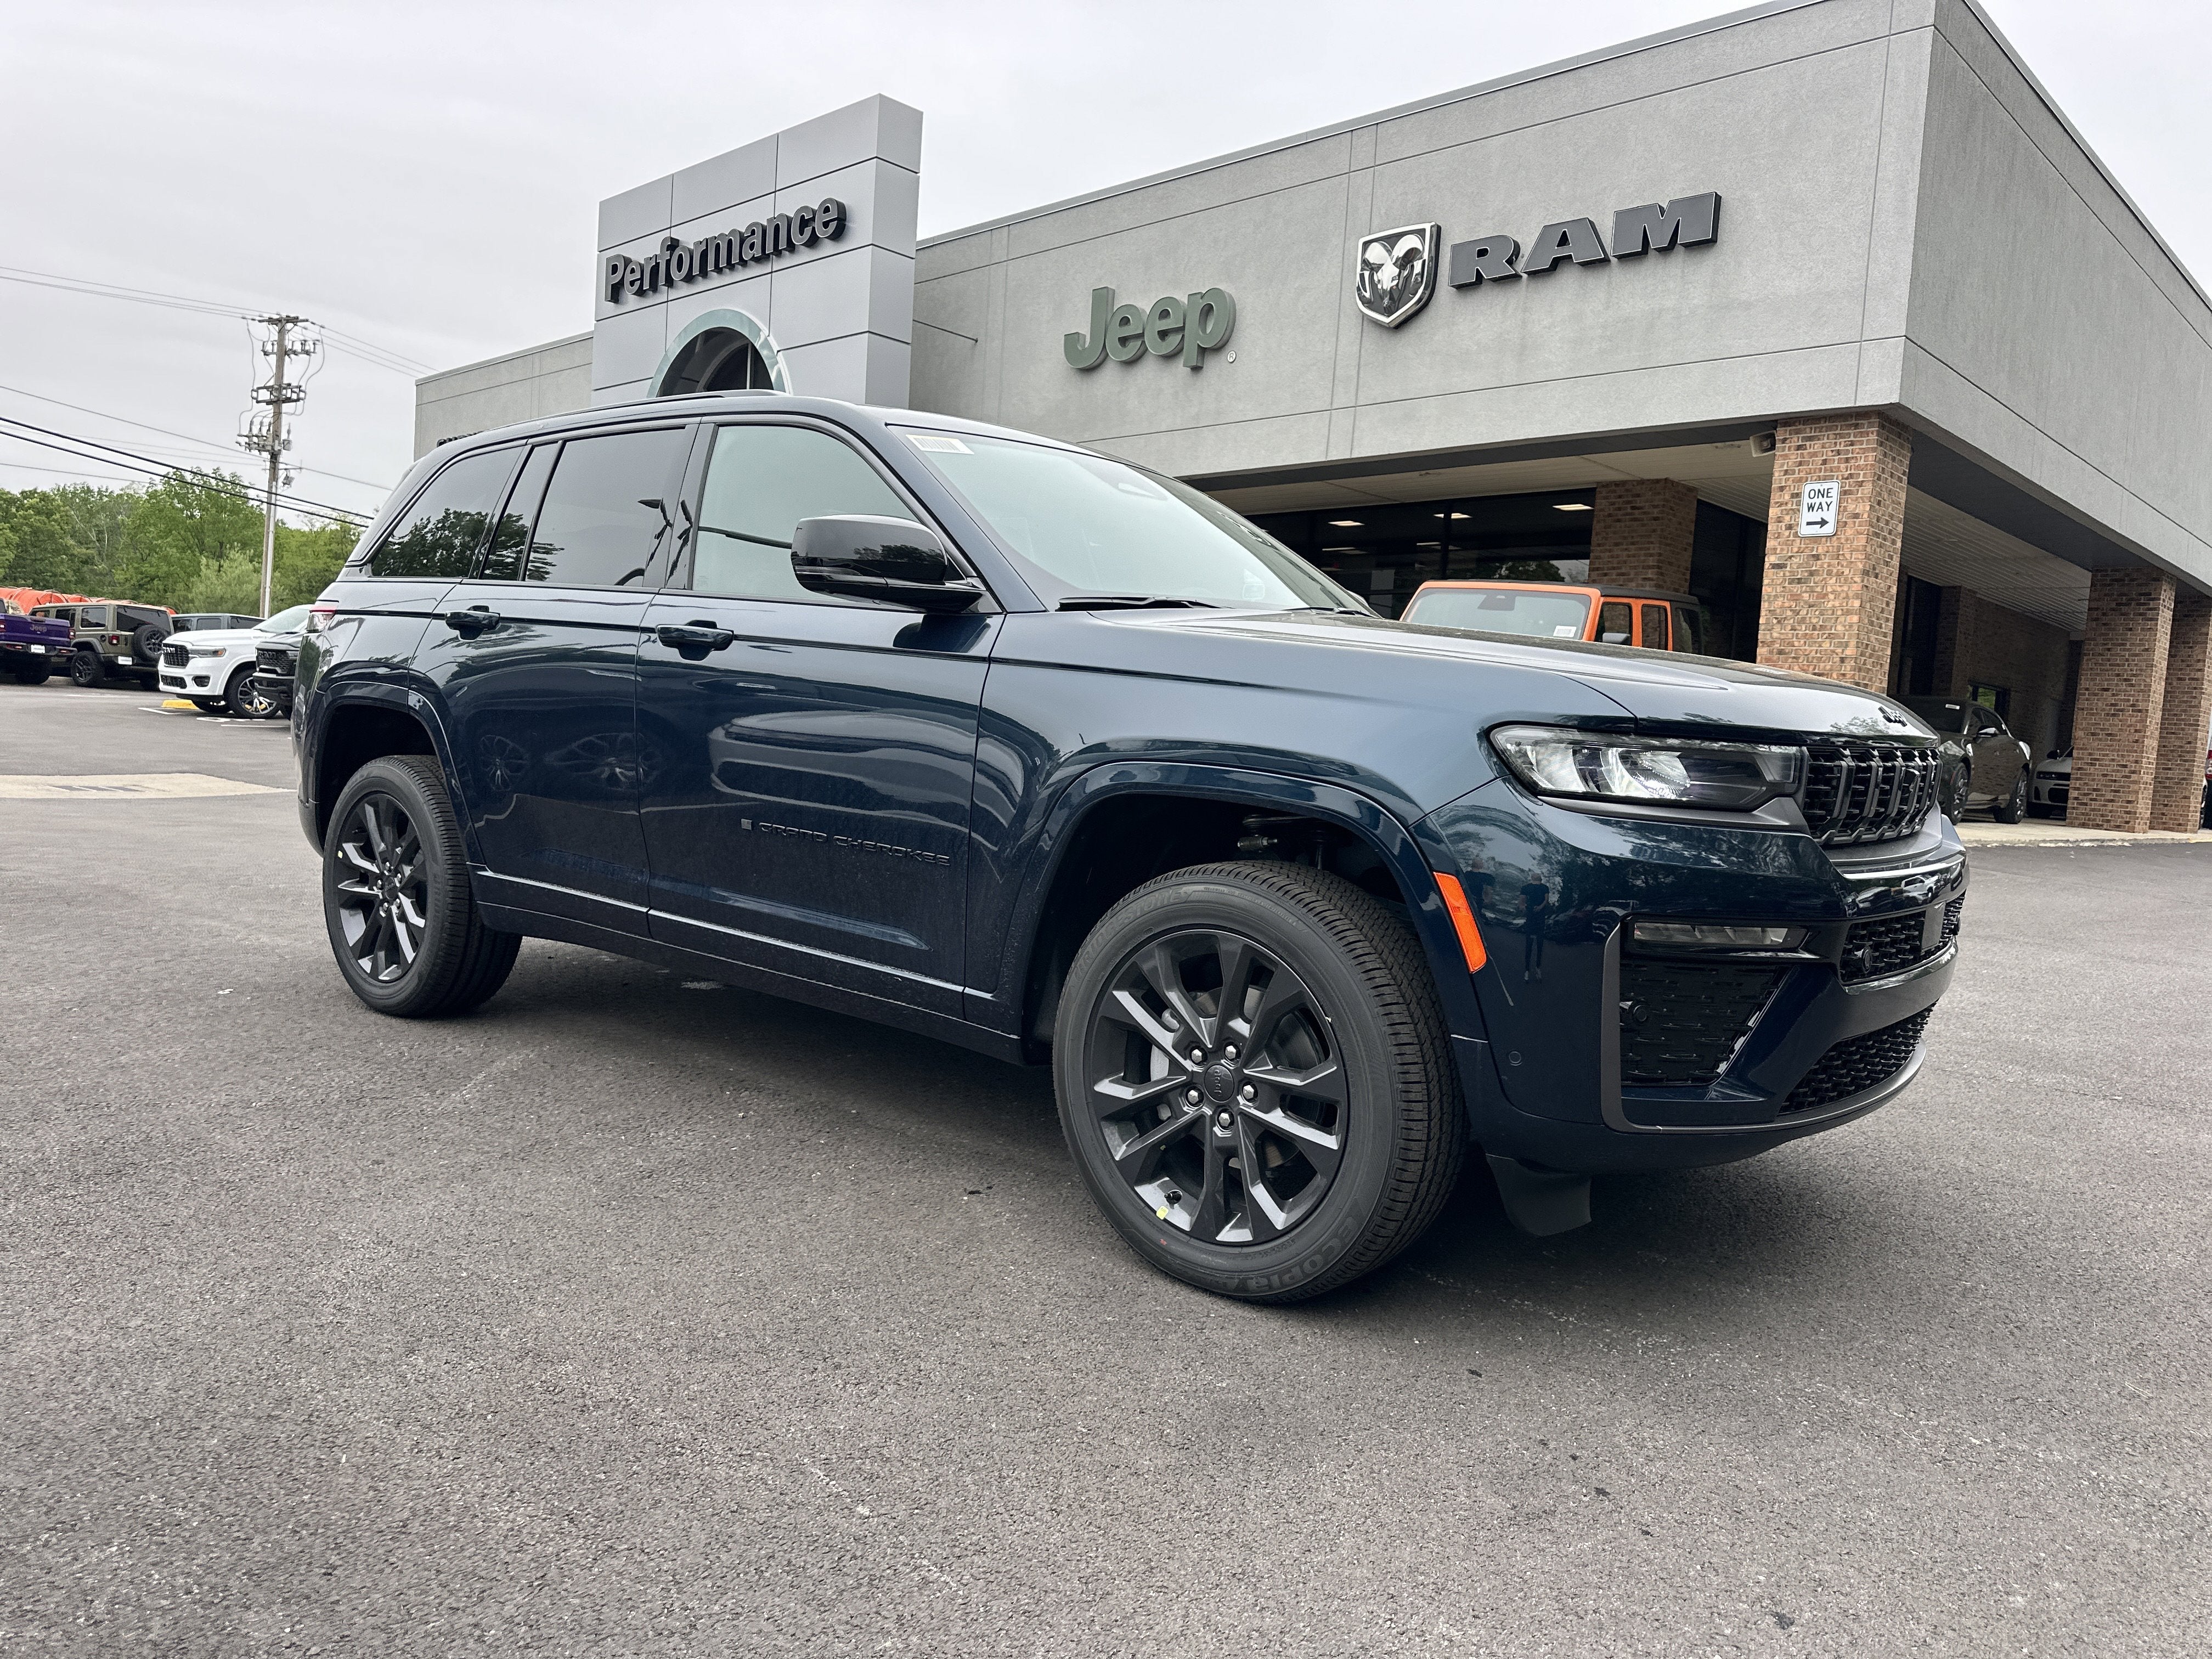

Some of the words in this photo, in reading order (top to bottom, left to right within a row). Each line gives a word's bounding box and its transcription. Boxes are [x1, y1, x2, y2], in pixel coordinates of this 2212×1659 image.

[605, 197, 847, 303] Performance
[1448, 191, 1722, 289] RAM
[1063, 286, 1237, 370] Jeep
[1807, 500, 1833, 513] WAY
[1808, 487, 1833, 499] ONE
[30, 624, 47, 633] Jeep
[759, 822, 828, 842] GRAND
[833, 835, 951, 866] CHEROKEE
